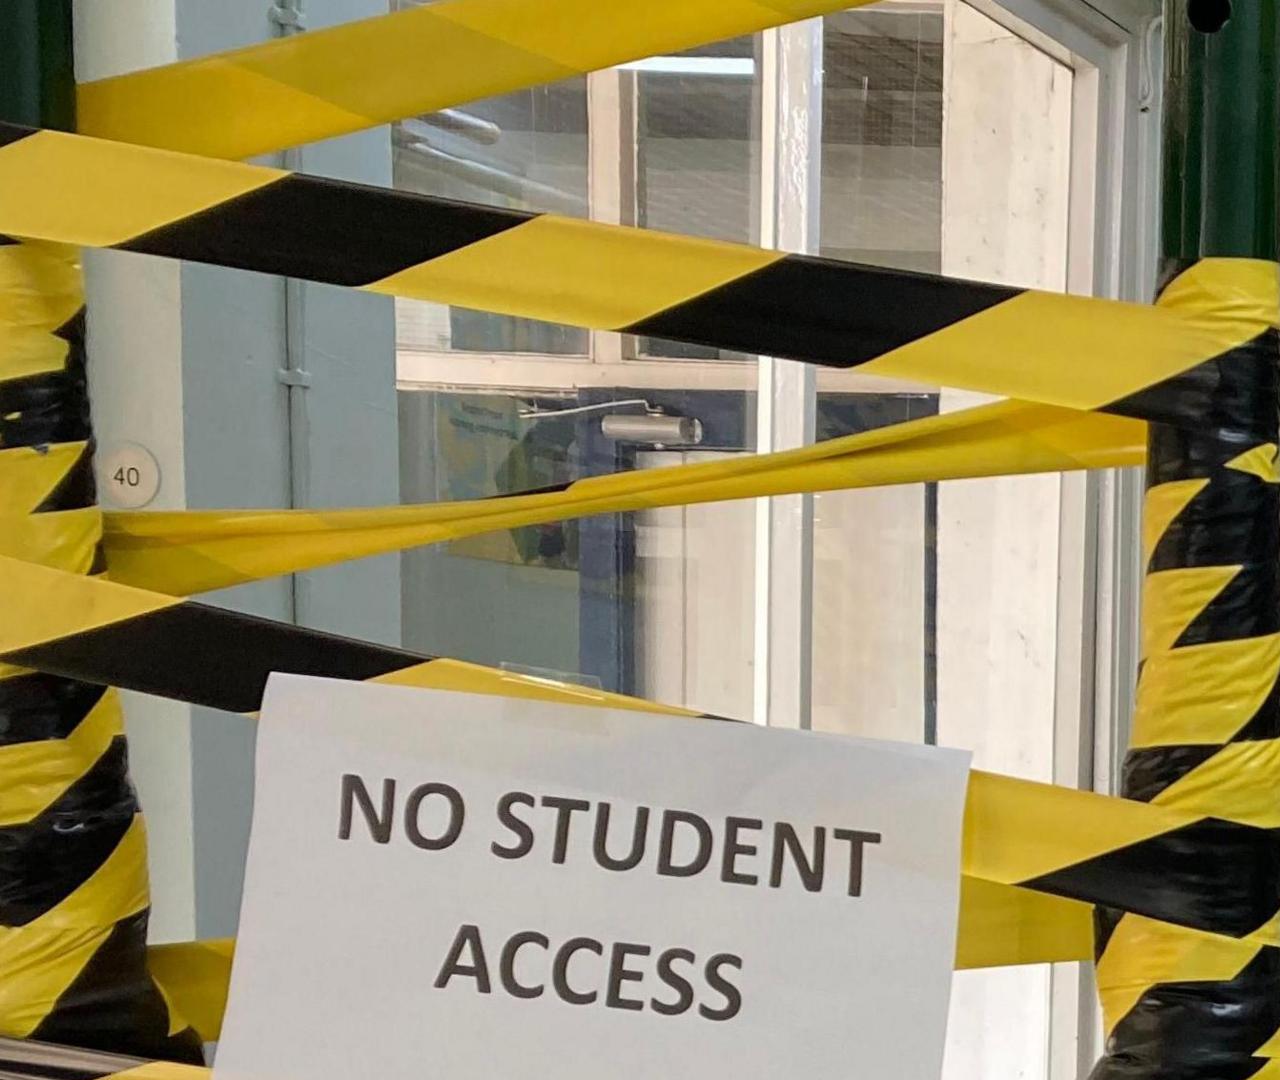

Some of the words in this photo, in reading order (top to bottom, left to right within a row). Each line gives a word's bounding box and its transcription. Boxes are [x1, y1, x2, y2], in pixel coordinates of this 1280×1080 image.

[113, 467, 140, 487] 40
[338, 774, 465, 851] NO
[491, 791, 882, 898] STUDENT
[434, 924, 744, 1022] ACCESS
